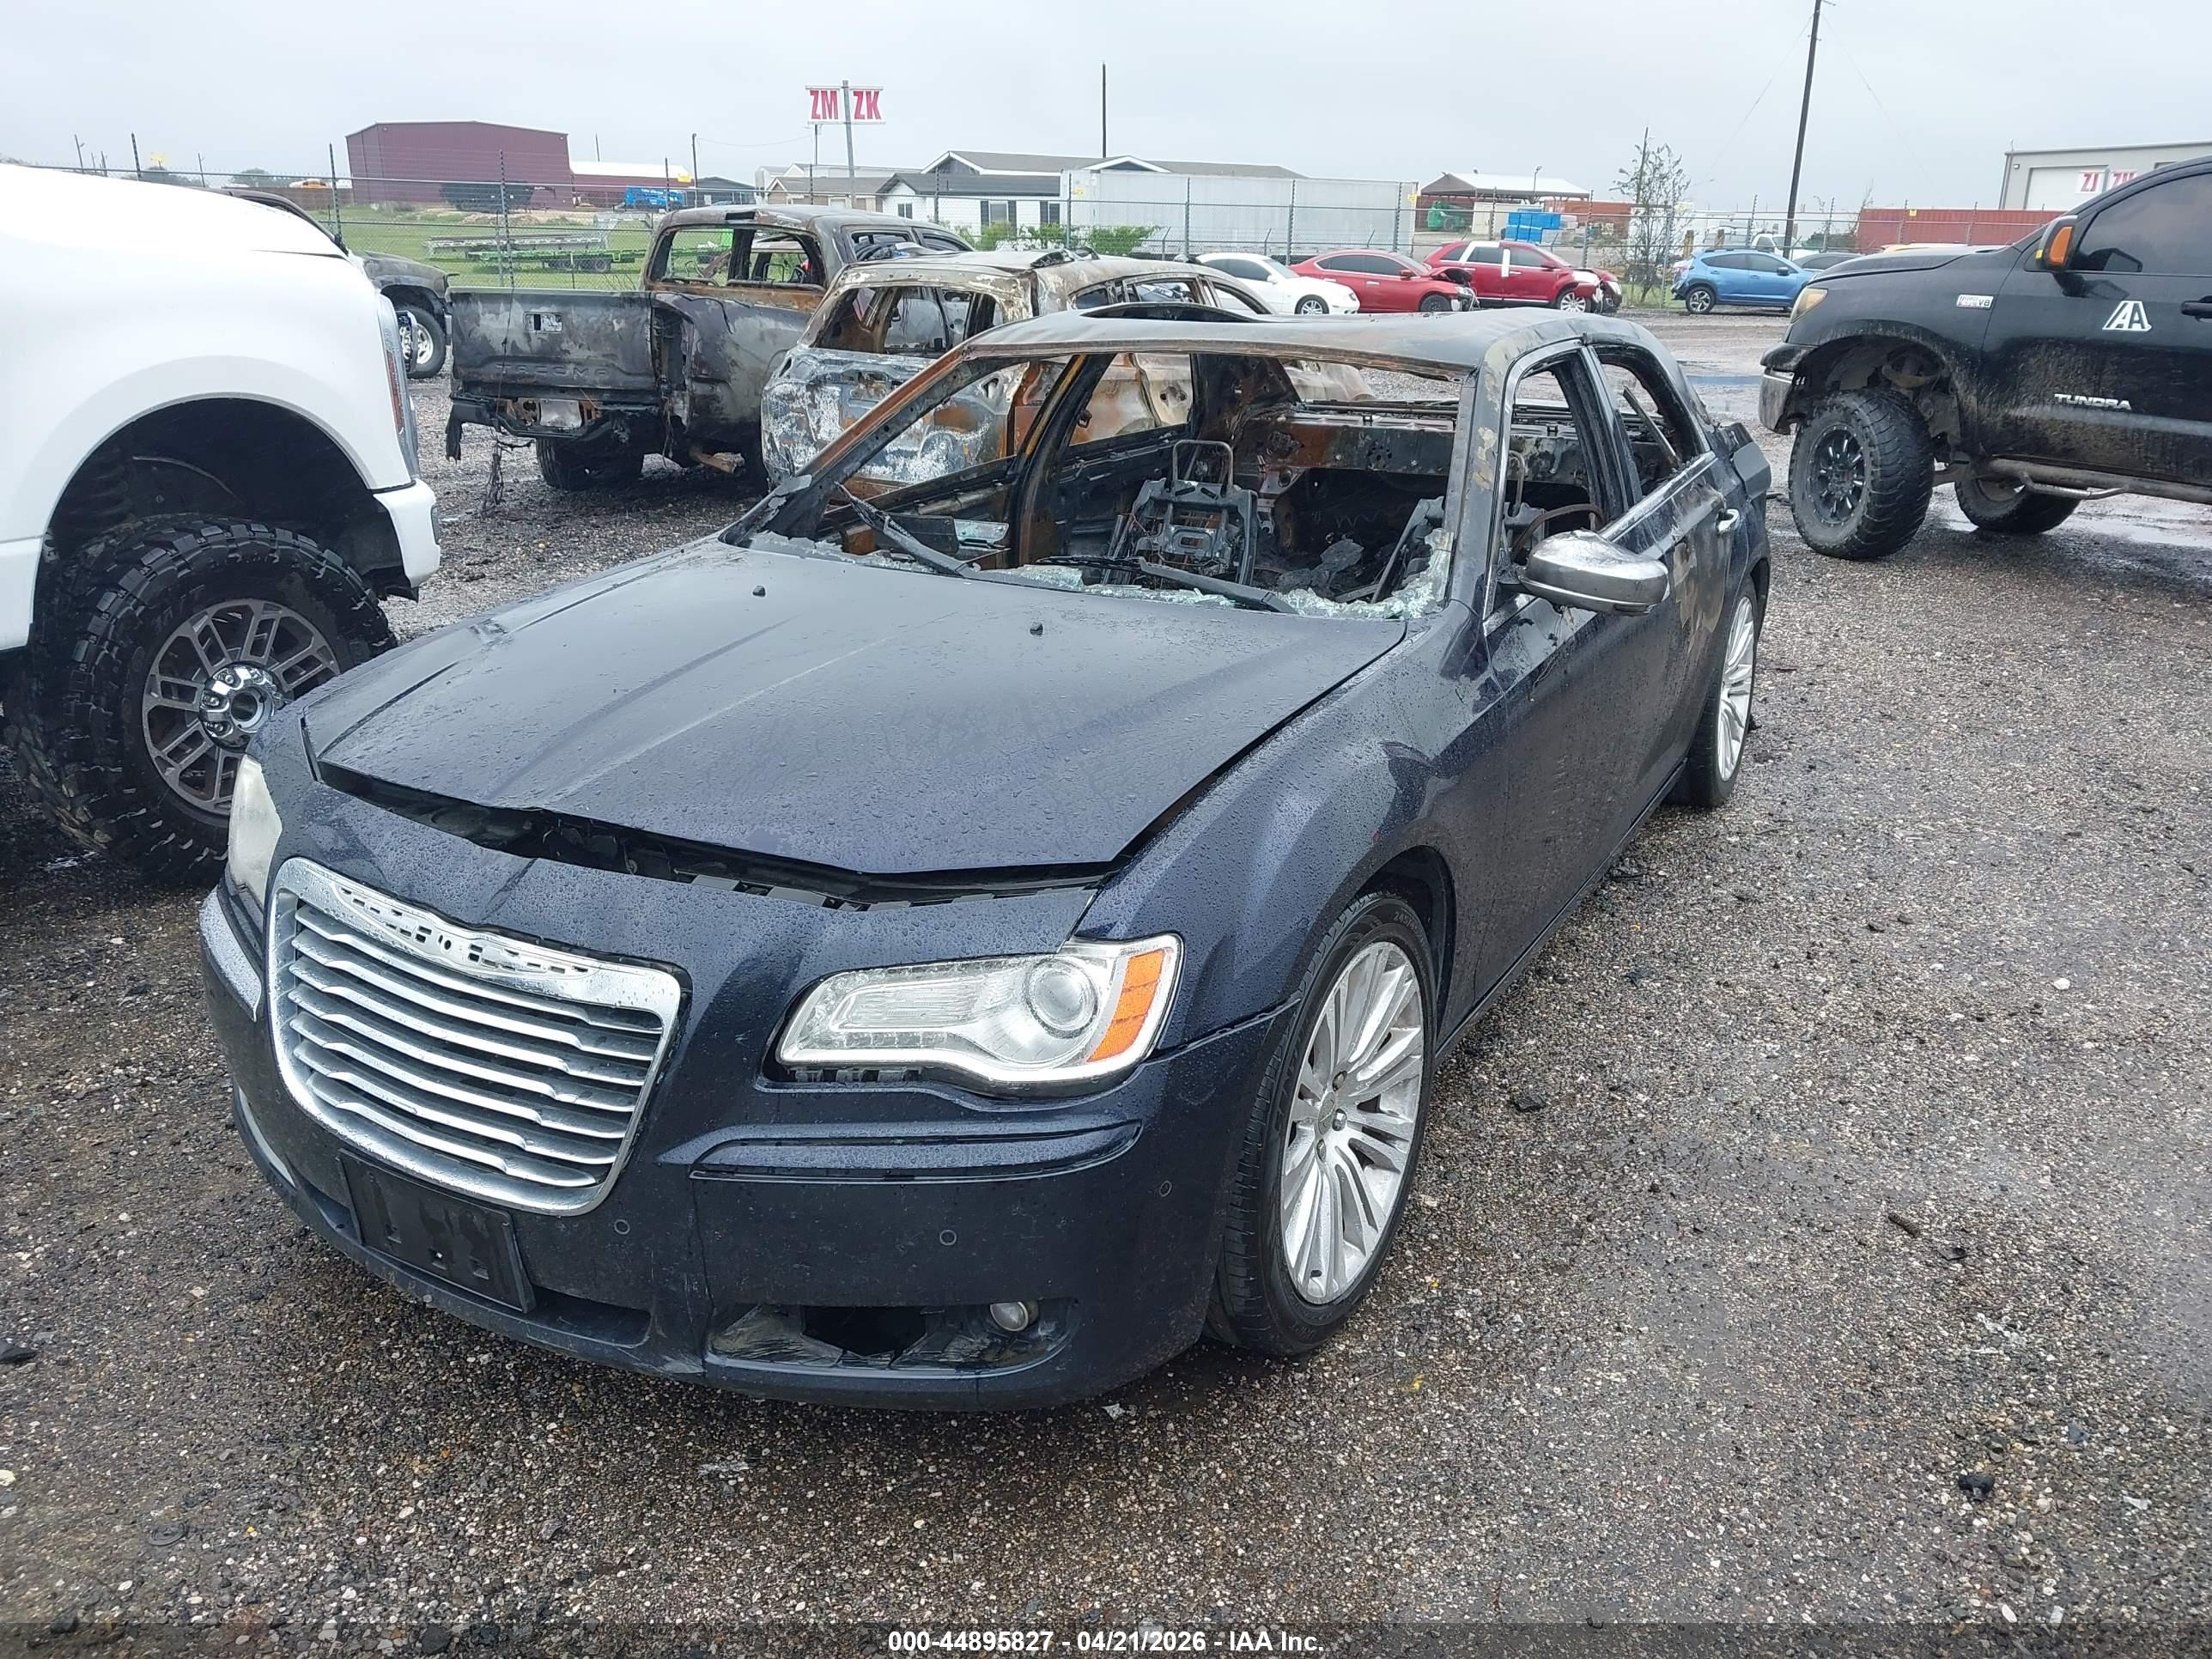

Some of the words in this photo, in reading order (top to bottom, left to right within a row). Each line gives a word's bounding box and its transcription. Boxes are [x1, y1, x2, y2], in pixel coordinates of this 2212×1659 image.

[810, 90, 839, 119] ZM
[853, 91, 882, 119] ZK
[495, 363, 610, 379] TACOMA
[2054, 393, 2131, 410] TUNDRA
